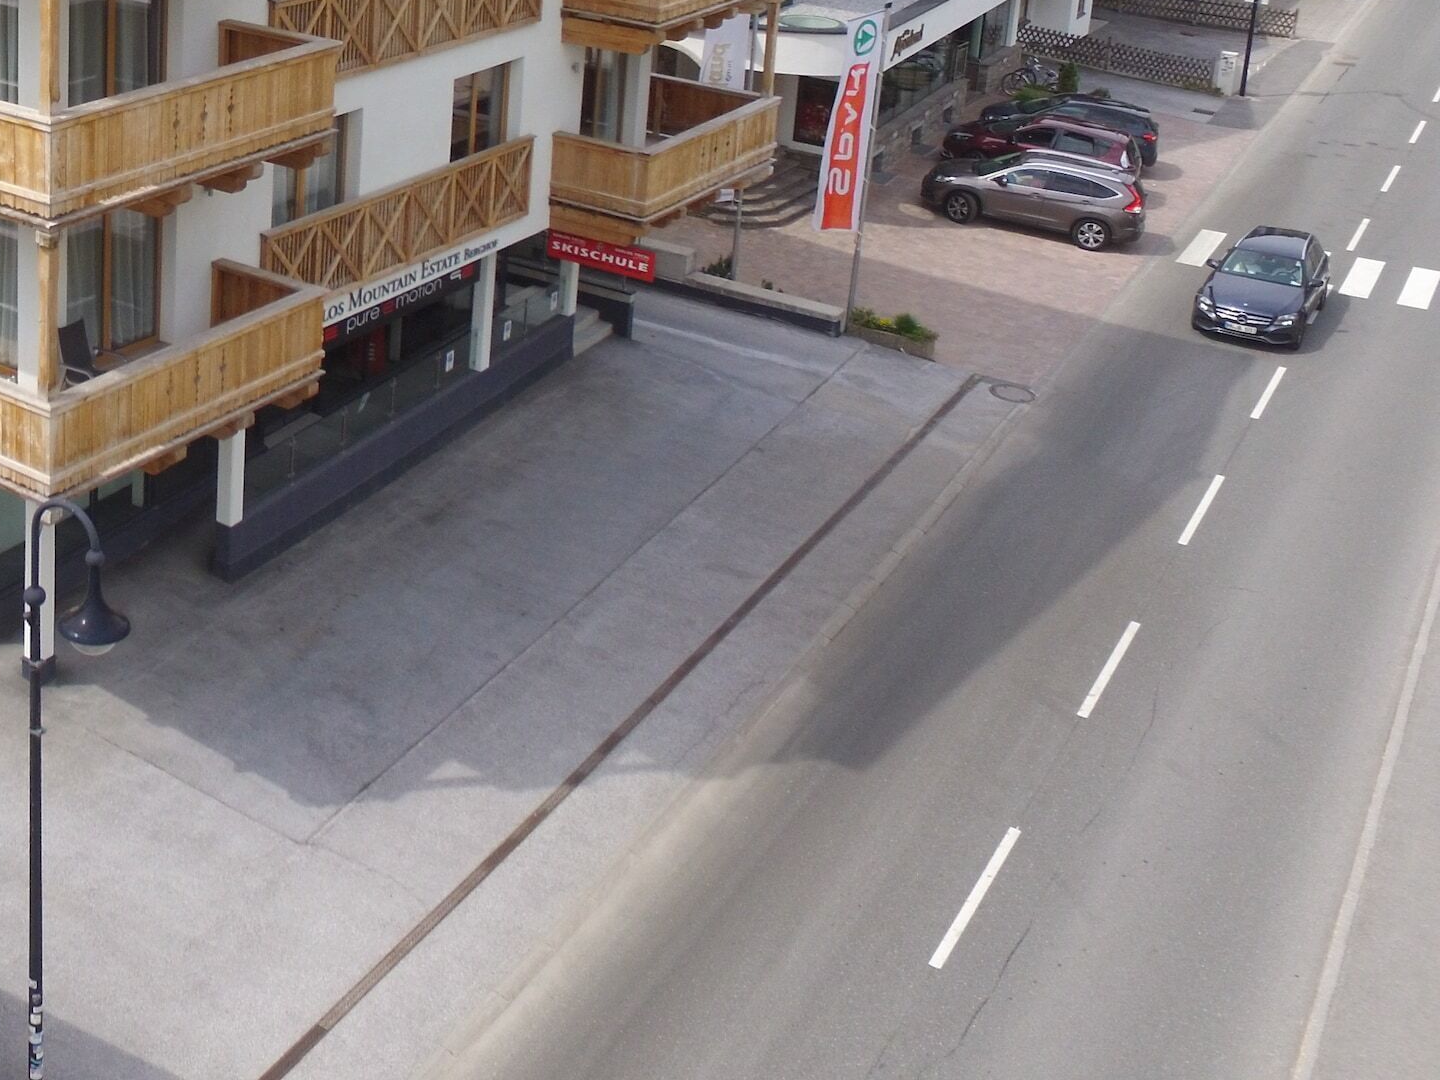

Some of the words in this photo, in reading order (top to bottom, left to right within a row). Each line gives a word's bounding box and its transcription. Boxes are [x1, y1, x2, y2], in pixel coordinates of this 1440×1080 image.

[348, 270, 417, 311] MOUNTAIN
[421, 251, 462, 280] ESTATE
[552, 240, 649, 273] SKISCHULE
[346, 306, 380, 335] pure
[395, 278, 443, 310] motion
